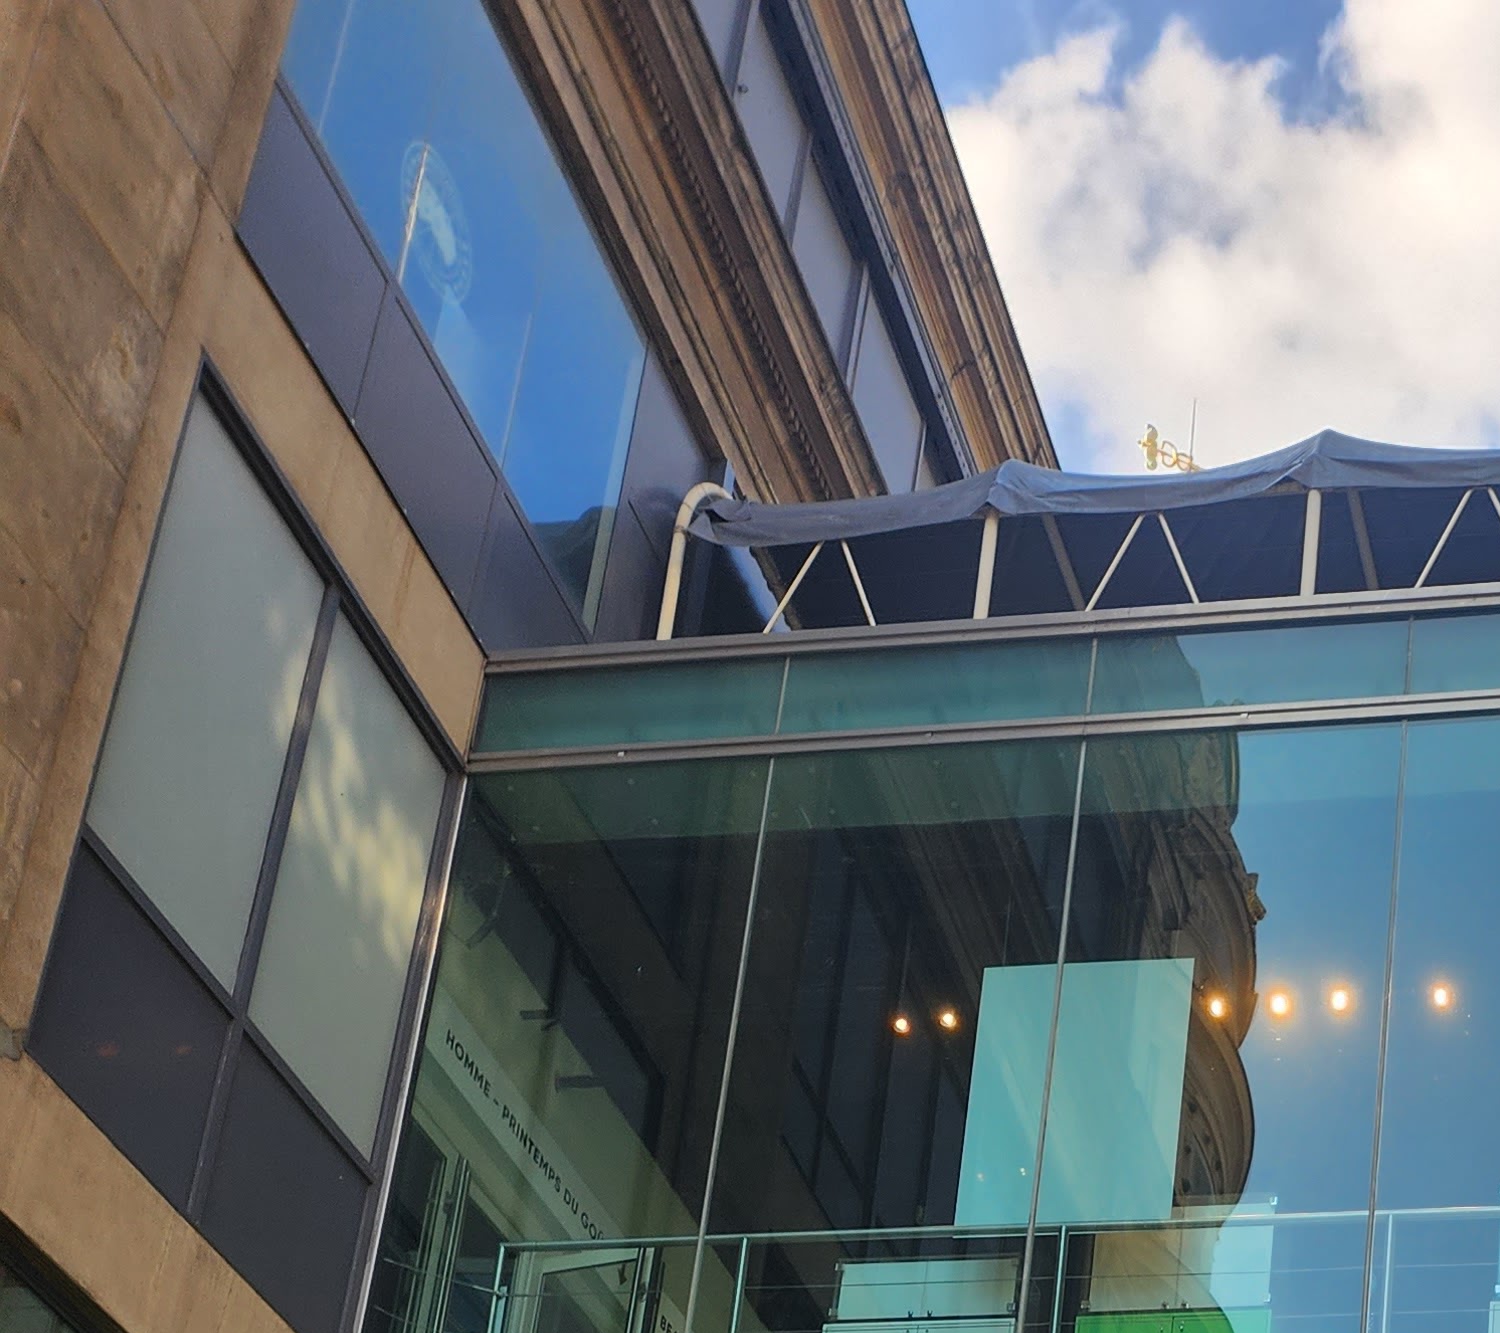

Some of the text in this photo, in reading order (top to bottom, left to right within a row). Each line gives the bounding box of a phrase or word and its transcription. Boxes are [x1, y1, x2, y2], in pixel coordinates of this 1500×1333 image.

[445, 1028, 491, 1099] HOMME
[502, 1105, 562, 1193] PRINTEMPS
[563, 1187, 580, 1215] DU
